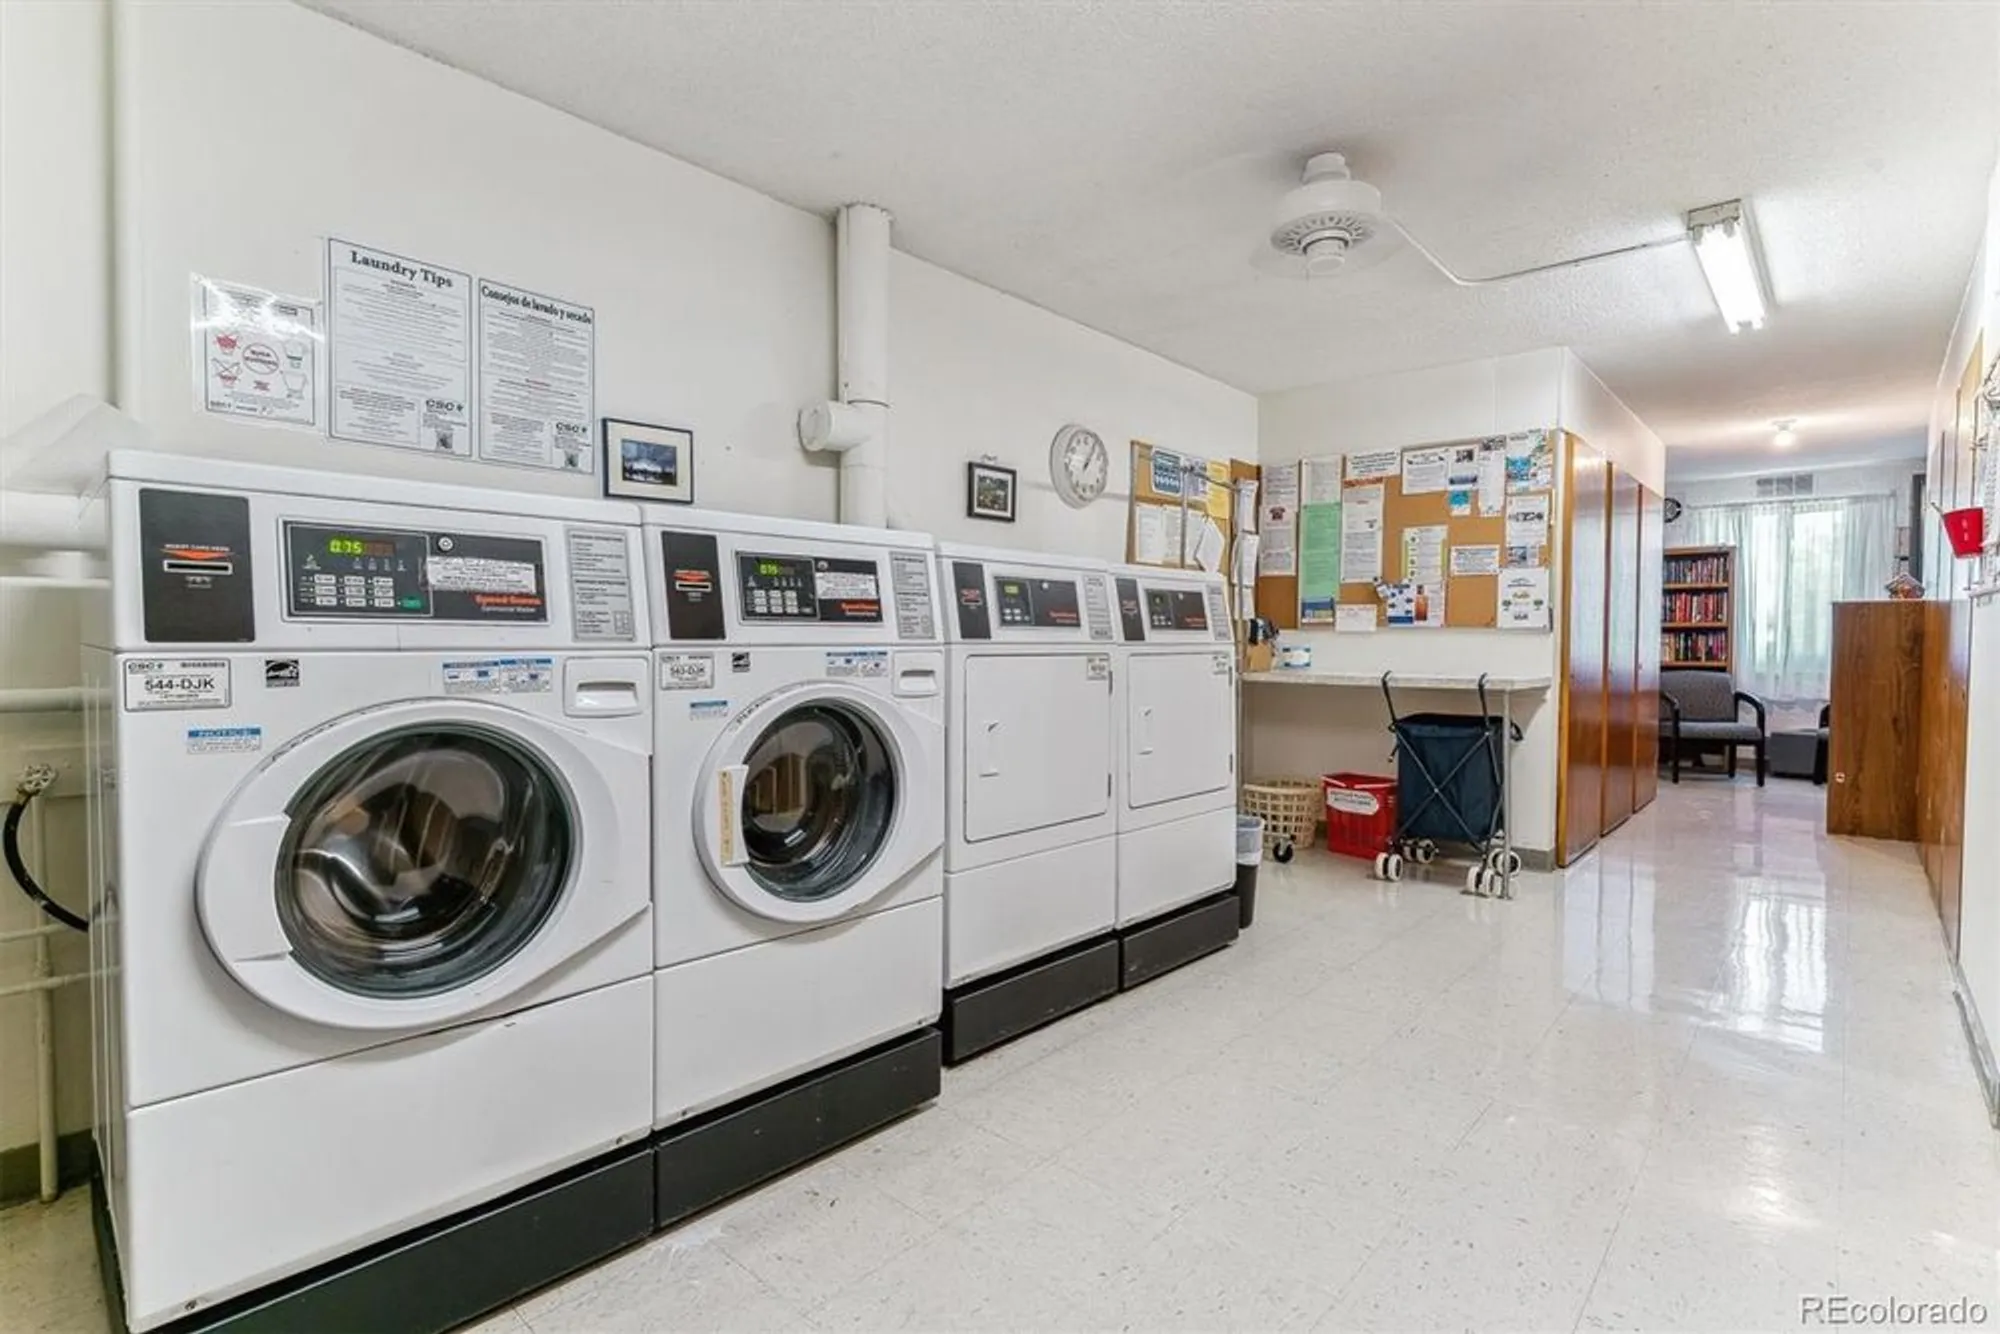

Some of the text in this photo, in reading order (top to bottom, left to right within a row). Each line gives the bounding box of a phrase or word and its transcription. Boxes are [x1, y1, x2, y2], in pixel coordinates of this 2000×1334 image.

[351, 250, 453, 289] Laundry Tips
[481, 285, 519, 306] Consejos
[521, 295, 531, 309] de
[532, 298, 557, 316] lavado
[145, 678, 215, 691] 544-DJK
